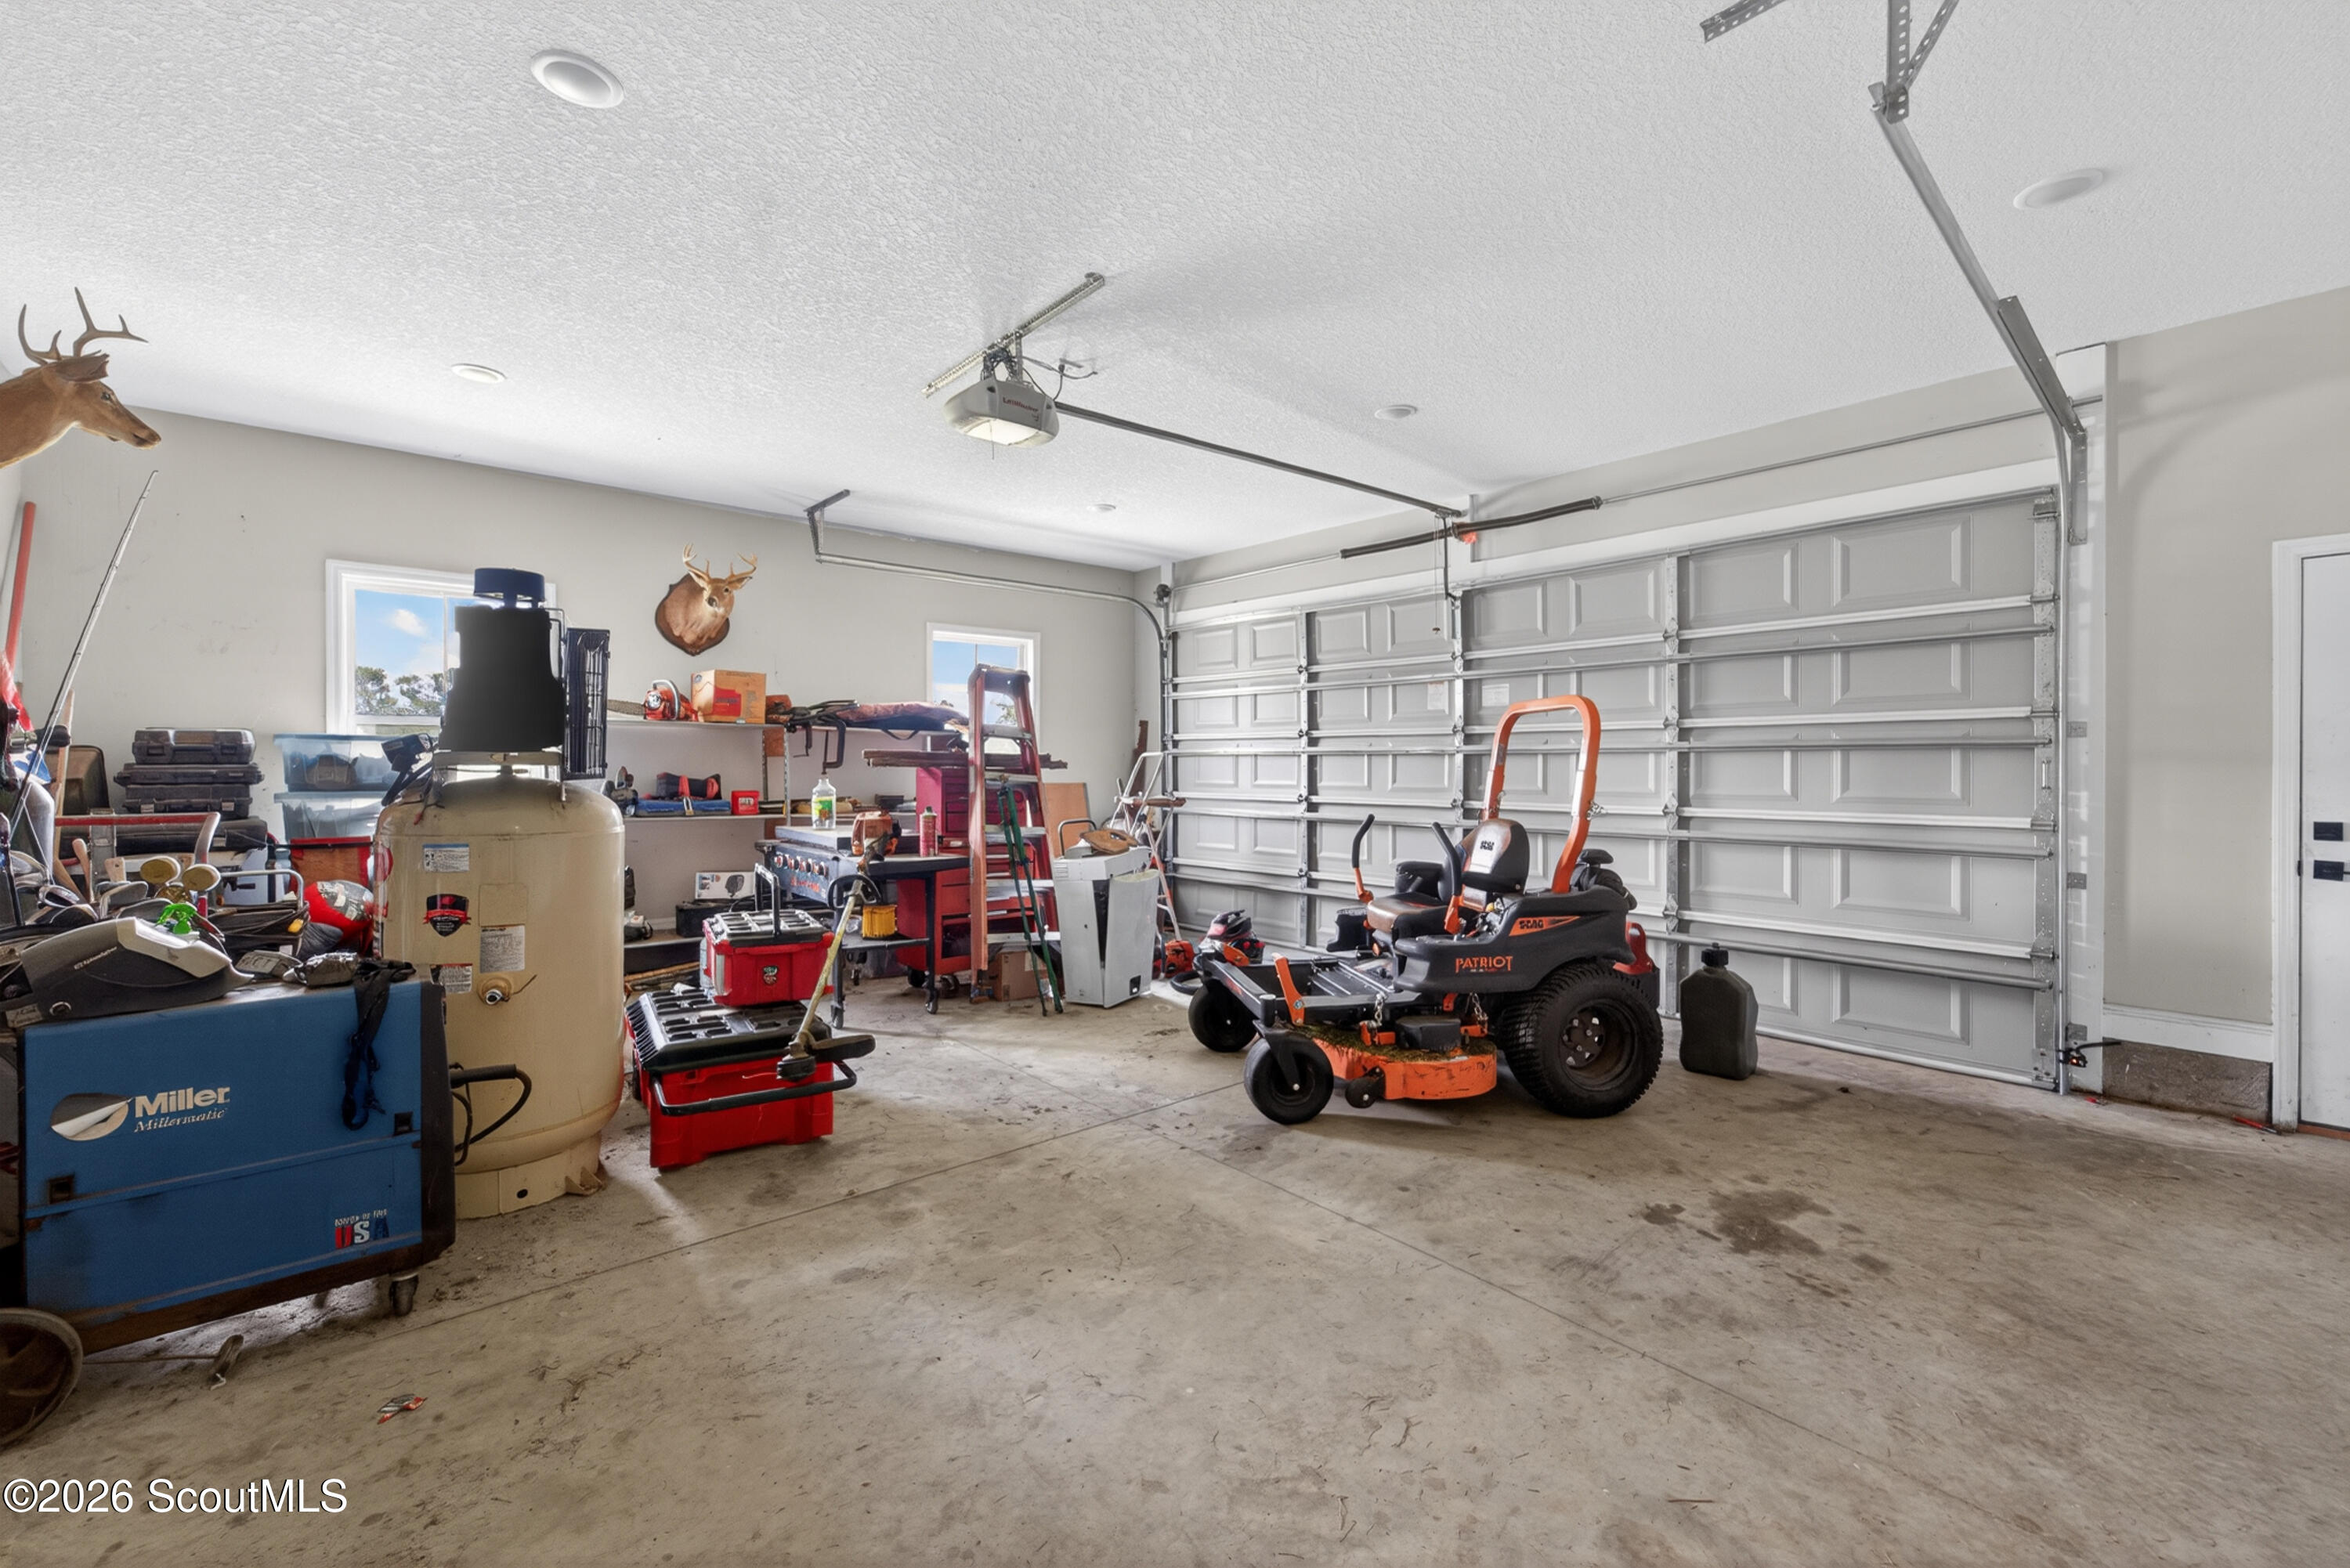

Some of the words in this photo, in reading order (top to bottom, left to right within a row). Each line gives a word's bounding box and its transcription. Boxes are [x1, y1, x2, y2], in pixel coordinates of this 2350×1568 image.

[1455, 956, 1513, 973] PATRIOT
[135, 1086, 230, 1118] Miller
[334, 1216, 389, 1249] USA
